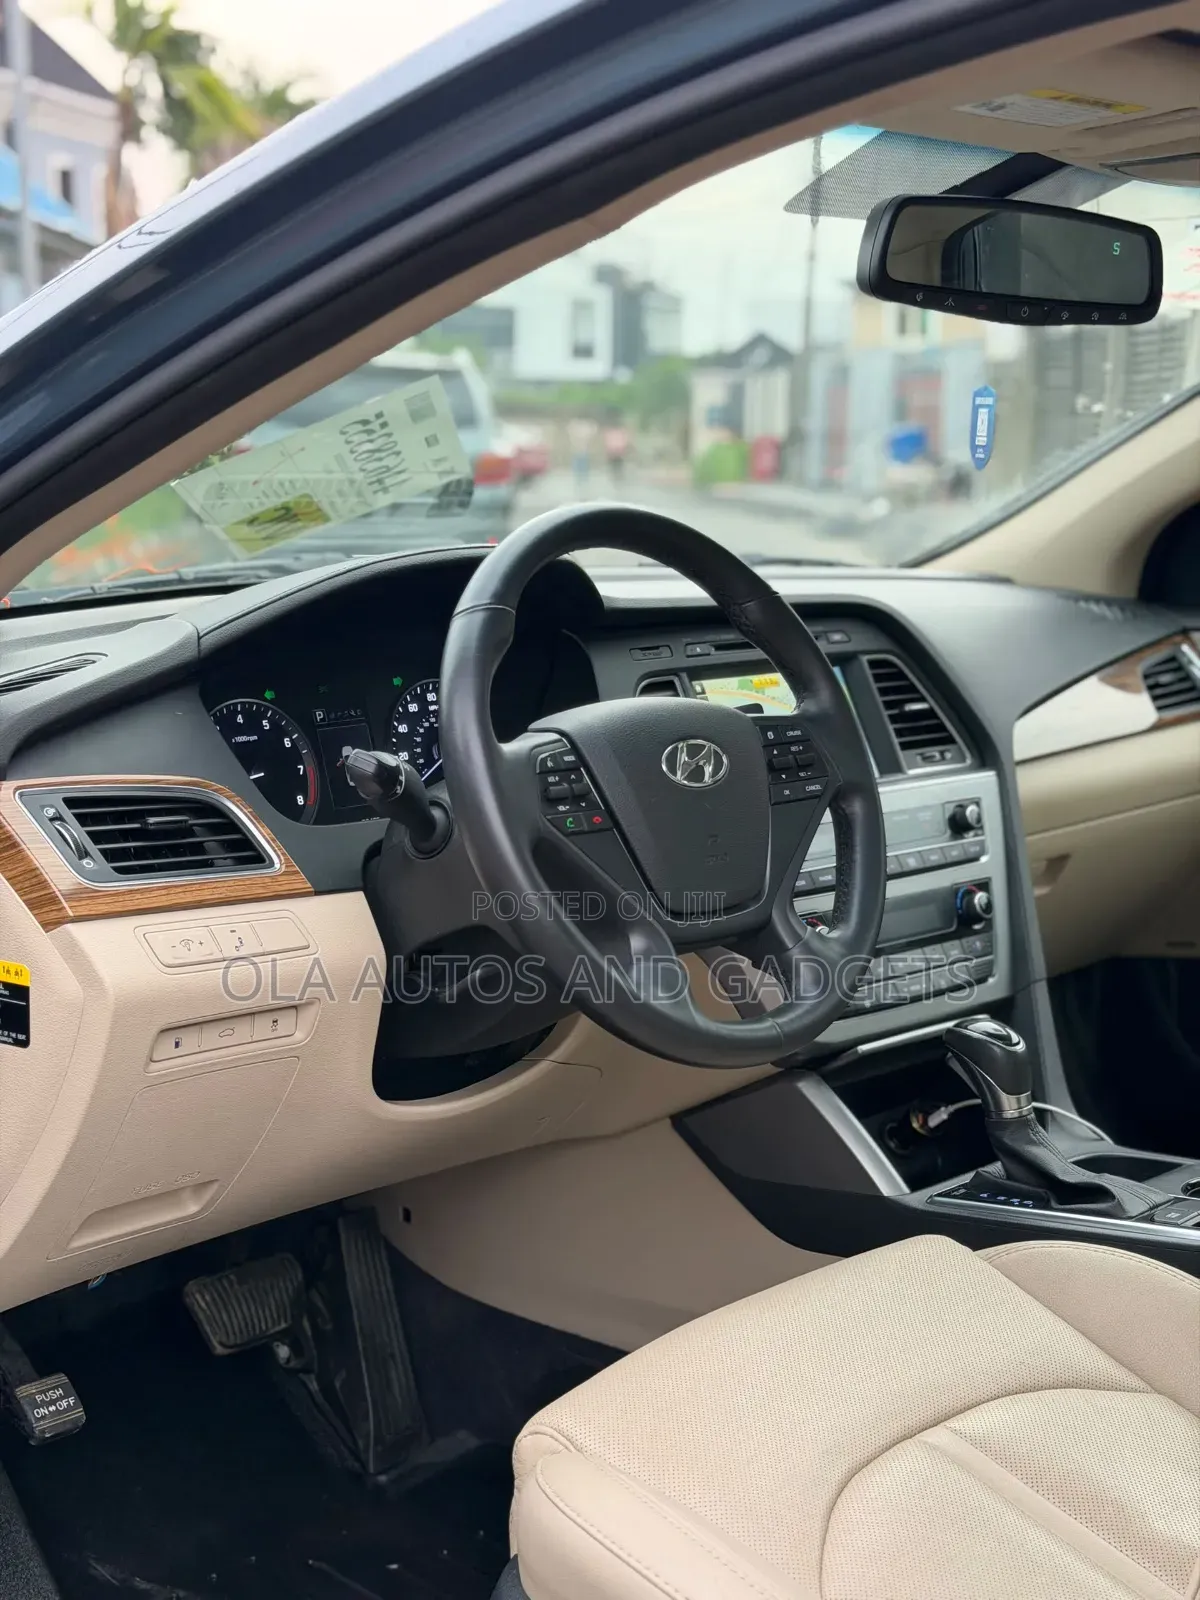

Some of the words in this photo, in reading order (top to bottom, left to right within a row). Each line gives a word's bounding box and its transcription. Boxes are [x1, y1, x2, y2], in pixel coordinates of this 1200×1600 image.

[426, 692, 437, 702] 80
[407, 703, 419, 713] 60
[236, 714, 244, 724] 4
[315, 711, 324, 722] P
[262, 719, 270, 730] 5
[397, 724, 408, 733] 40
[283, 737, 292, 748] 6
[398, 751, 409, 761] 20
[297, 765, 304, 775] 7
[296, 795, 305, 805] 8
[35, 1387, 64, 1404] PUSH
[33, 1405, 49, 1418] ON
[56, 1396, 76, 1411] OFF
